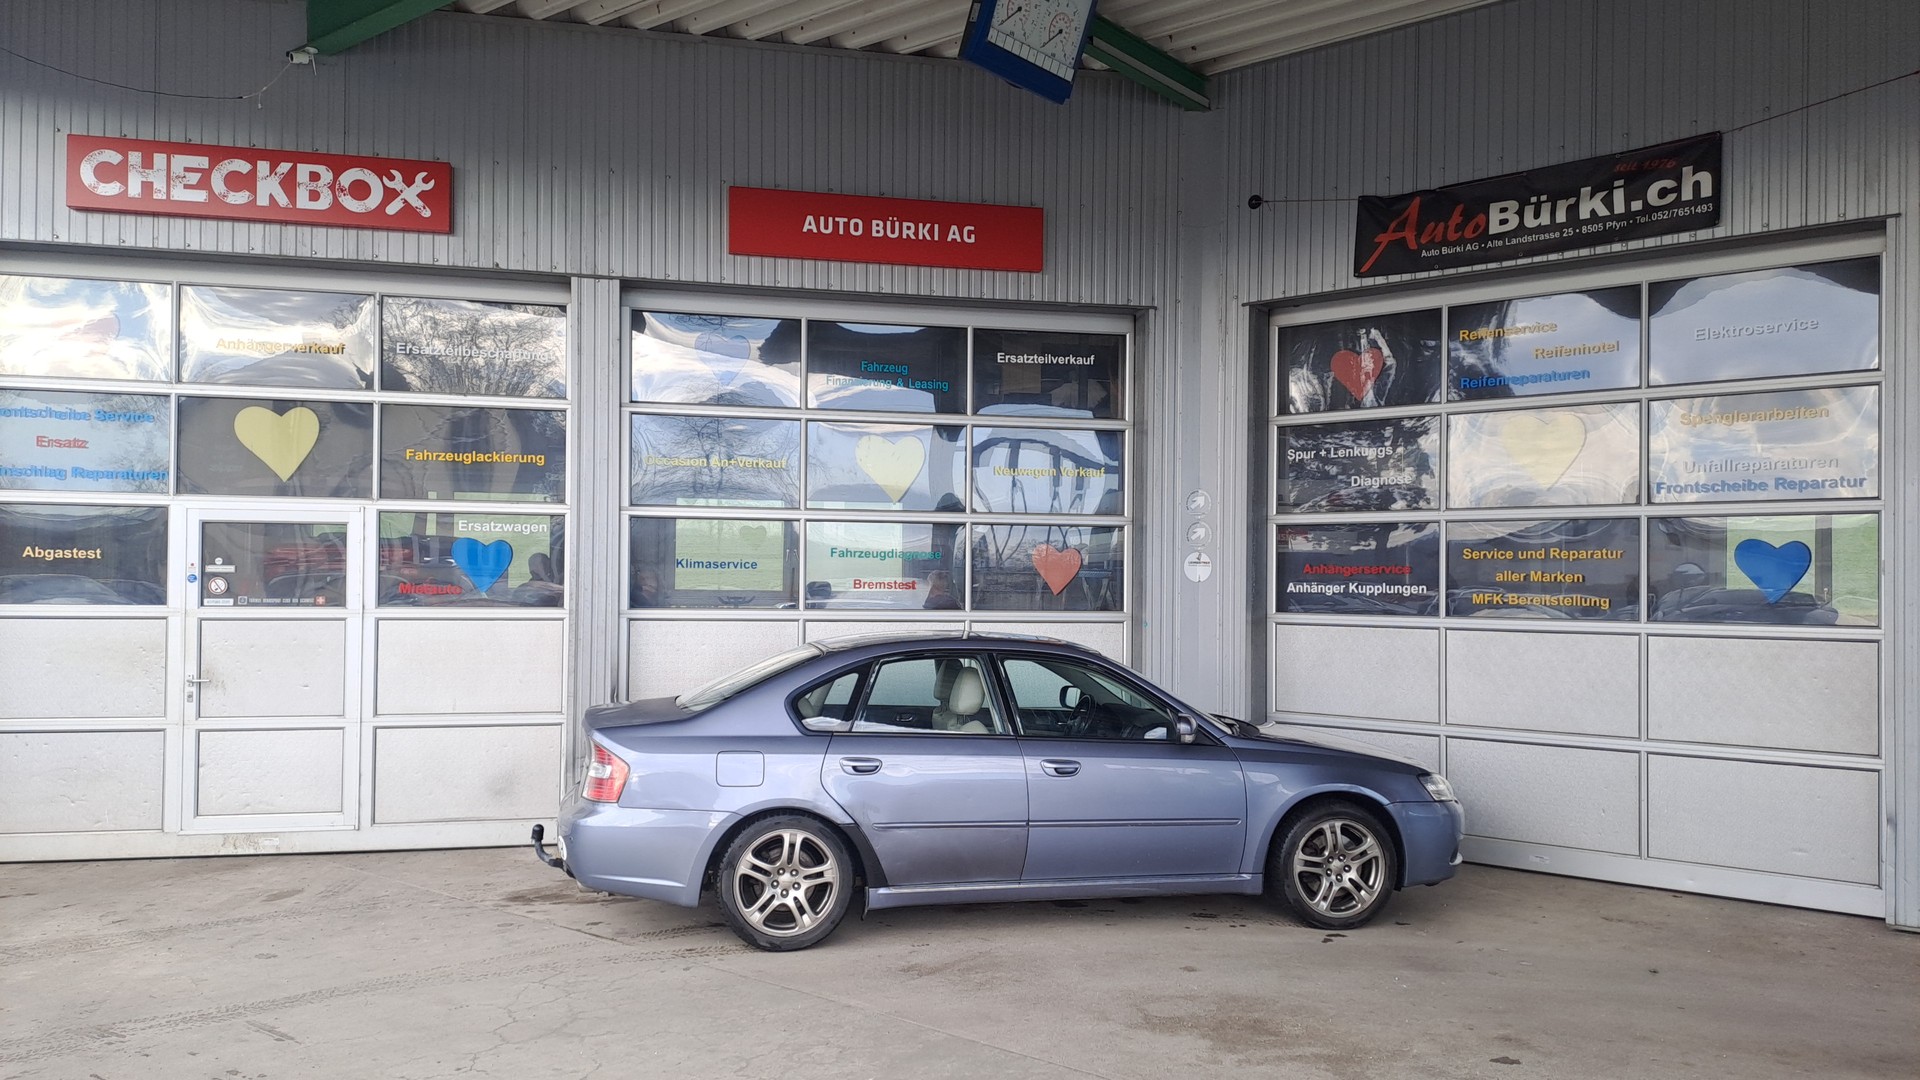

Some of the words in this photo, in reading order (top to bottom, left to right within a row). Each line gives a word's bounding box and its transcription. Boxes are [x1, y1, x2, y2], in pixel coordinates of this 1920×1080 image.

[802, 215, 863, 236] AUTO
[871, 216, 939, 241] BÜRKI
[946, 224, 976, 244] AG
[1421, 248, 1440, 258] Auto
[1441, 244, 1464, 255] Bürki
[1465, 242, 1479, 251] AG
[1486, 240, 1503, 249] Alte
[1505, 230, 1560, 245] Landstrasse
[1562, 228, 1574, 237] 25
[1581, 224, 1604, 234] 8505
[1605, 220, 1627, 232] Pfyn
[1459, 321, 1558, 341] Reifenservice
[1694, 318, 1819, 341] Elektroservice
[216, 338, 346, 355] Anhängerverkauf
[1534, 340, 1619, 360] Reifenhotel
[997, 352, 1095, 366] Ersatzteilverkauf
[861, 361, 908, 375] Fahrzeug
[826, 375, 892, 389] Finanerung
[896, 378, 904, 388] &
[908, 378, 949, 392] Leasing
[1460, 369, 1590, 389] Reifenreparaturen
[94, 408, 155, 423] Service
[1680, 406, 1829, 427] Spenglerarbeiten
[36, 435, 89, 449] Ersatz
[406, 449, 545, 466] Fahrzeuglackierung
[1287, 449, 1316, 462] Spur
[1330, 446, 1393, 459] Lenkungs
[644, 455, 707, 467] Occasion
[710, 455, 787, 469] An+Verkauf
[1682, 457, 1838, 475] Unfallreparaturen
[71, 466, 168, 482] Reparaturen
[994, 465, 1056, 479] Neuwagen
[1060, 466, 1105, 478] Verkauf
[1351, 474, 1412, 488] Diagnose
[1655, 476, 1768, 495] Frontscheibe
[1774, 475, 1867, 492] Reparatur
[458, 520, 547, 534] Ersatzwagen
[22, 546, 102, 561] Abgastest
[830, 547, 942, 561] Fahrzeugdiagnose
[1463, 547, 1514, 560] Service
[1518, 547, 1545, 560] und
[1550, 547, 1623, 562] Reparatur
[676, 558, 758, 570] Klimaservice
[1303, 563, 1412, 577] Anhängerservice
[1495, 571, 1526, 582] aller
[1530, 570, 1583, 583] Marken
[398, 582, 463, 595] Mietauto
[853, 579, 917, 590] Bremstest
[1287, 582, 1346, 595] Anhänger
[1349, 582, 1427, 596] Kupplungen
[1472, 593, 1610, 609] MFK-Bereitstellung
